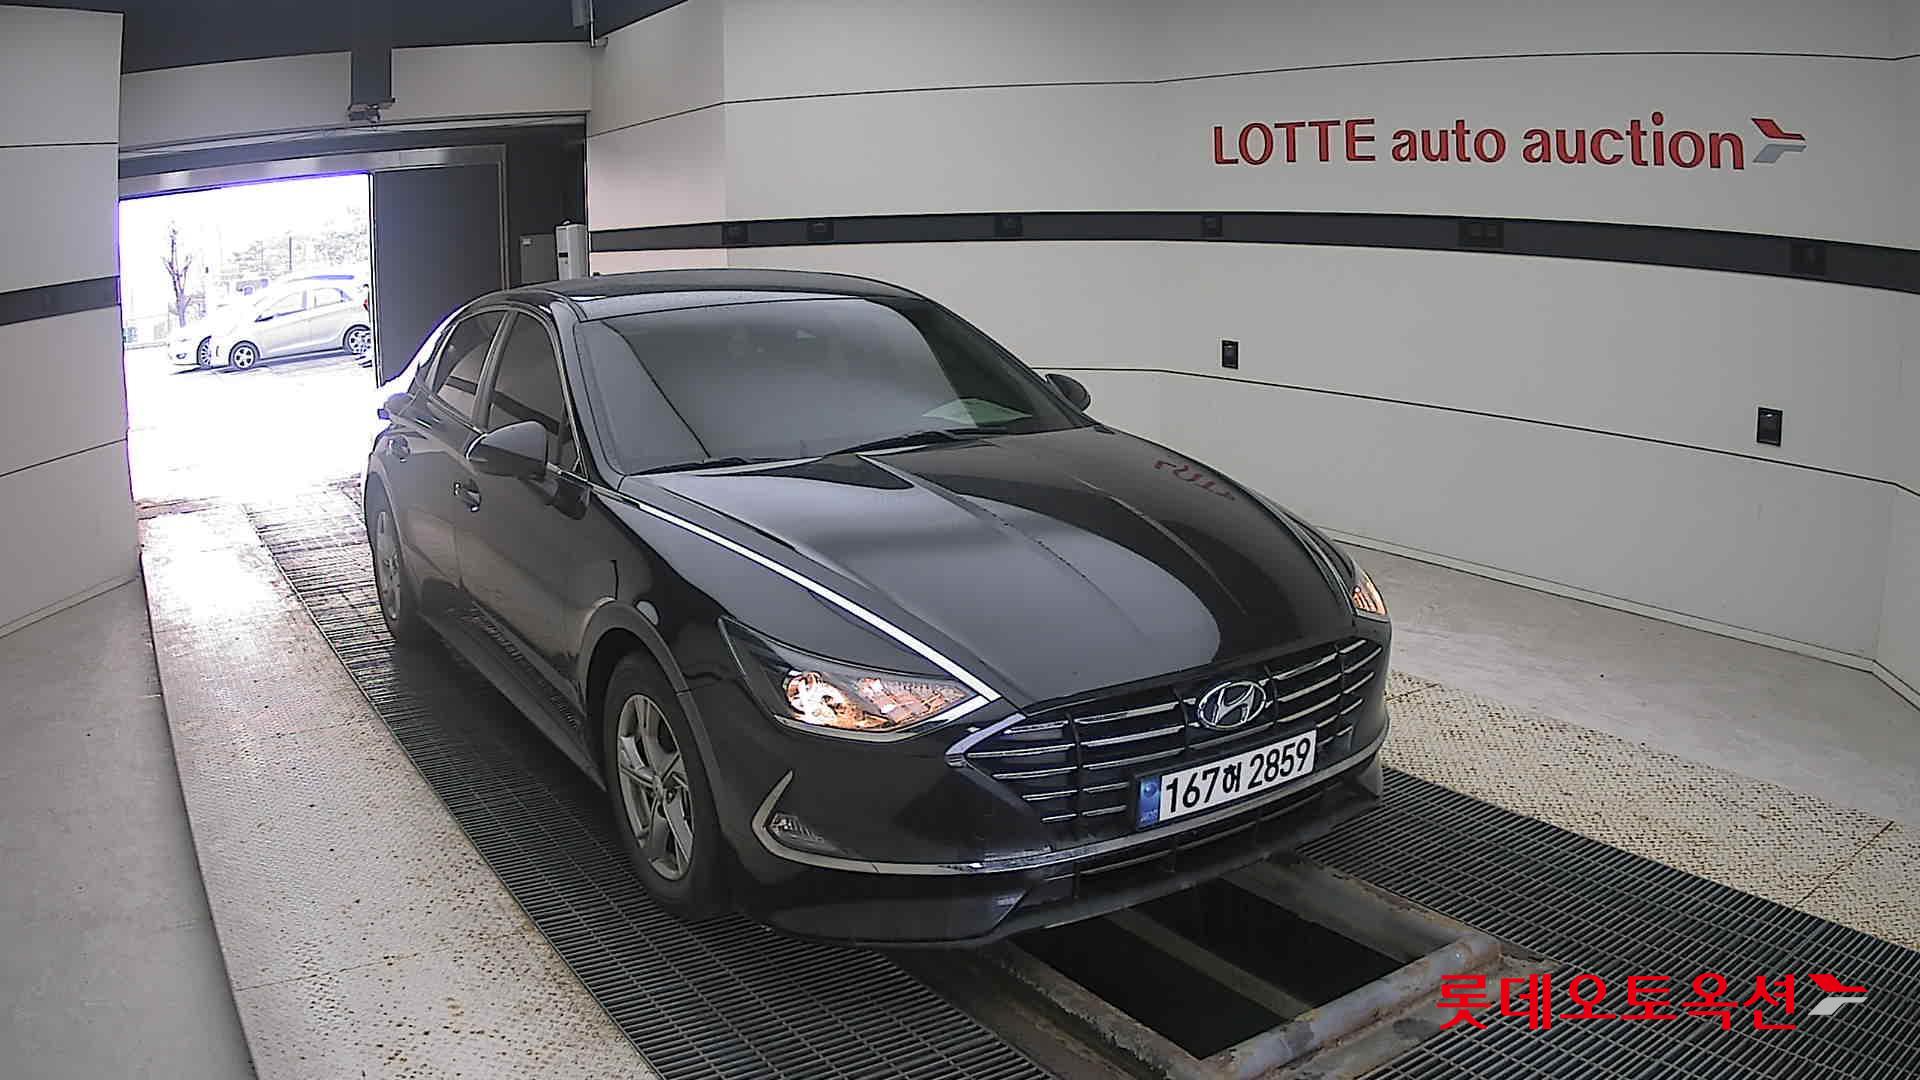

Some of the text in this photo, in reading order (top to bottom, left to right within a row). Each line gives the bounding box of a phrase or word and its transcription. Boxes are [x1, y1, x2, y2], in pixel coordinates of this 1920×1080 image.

[1213, 111, 1745, 170] LOTTE auto auction
[1166, 737, 1311, 813] 167허 2859
